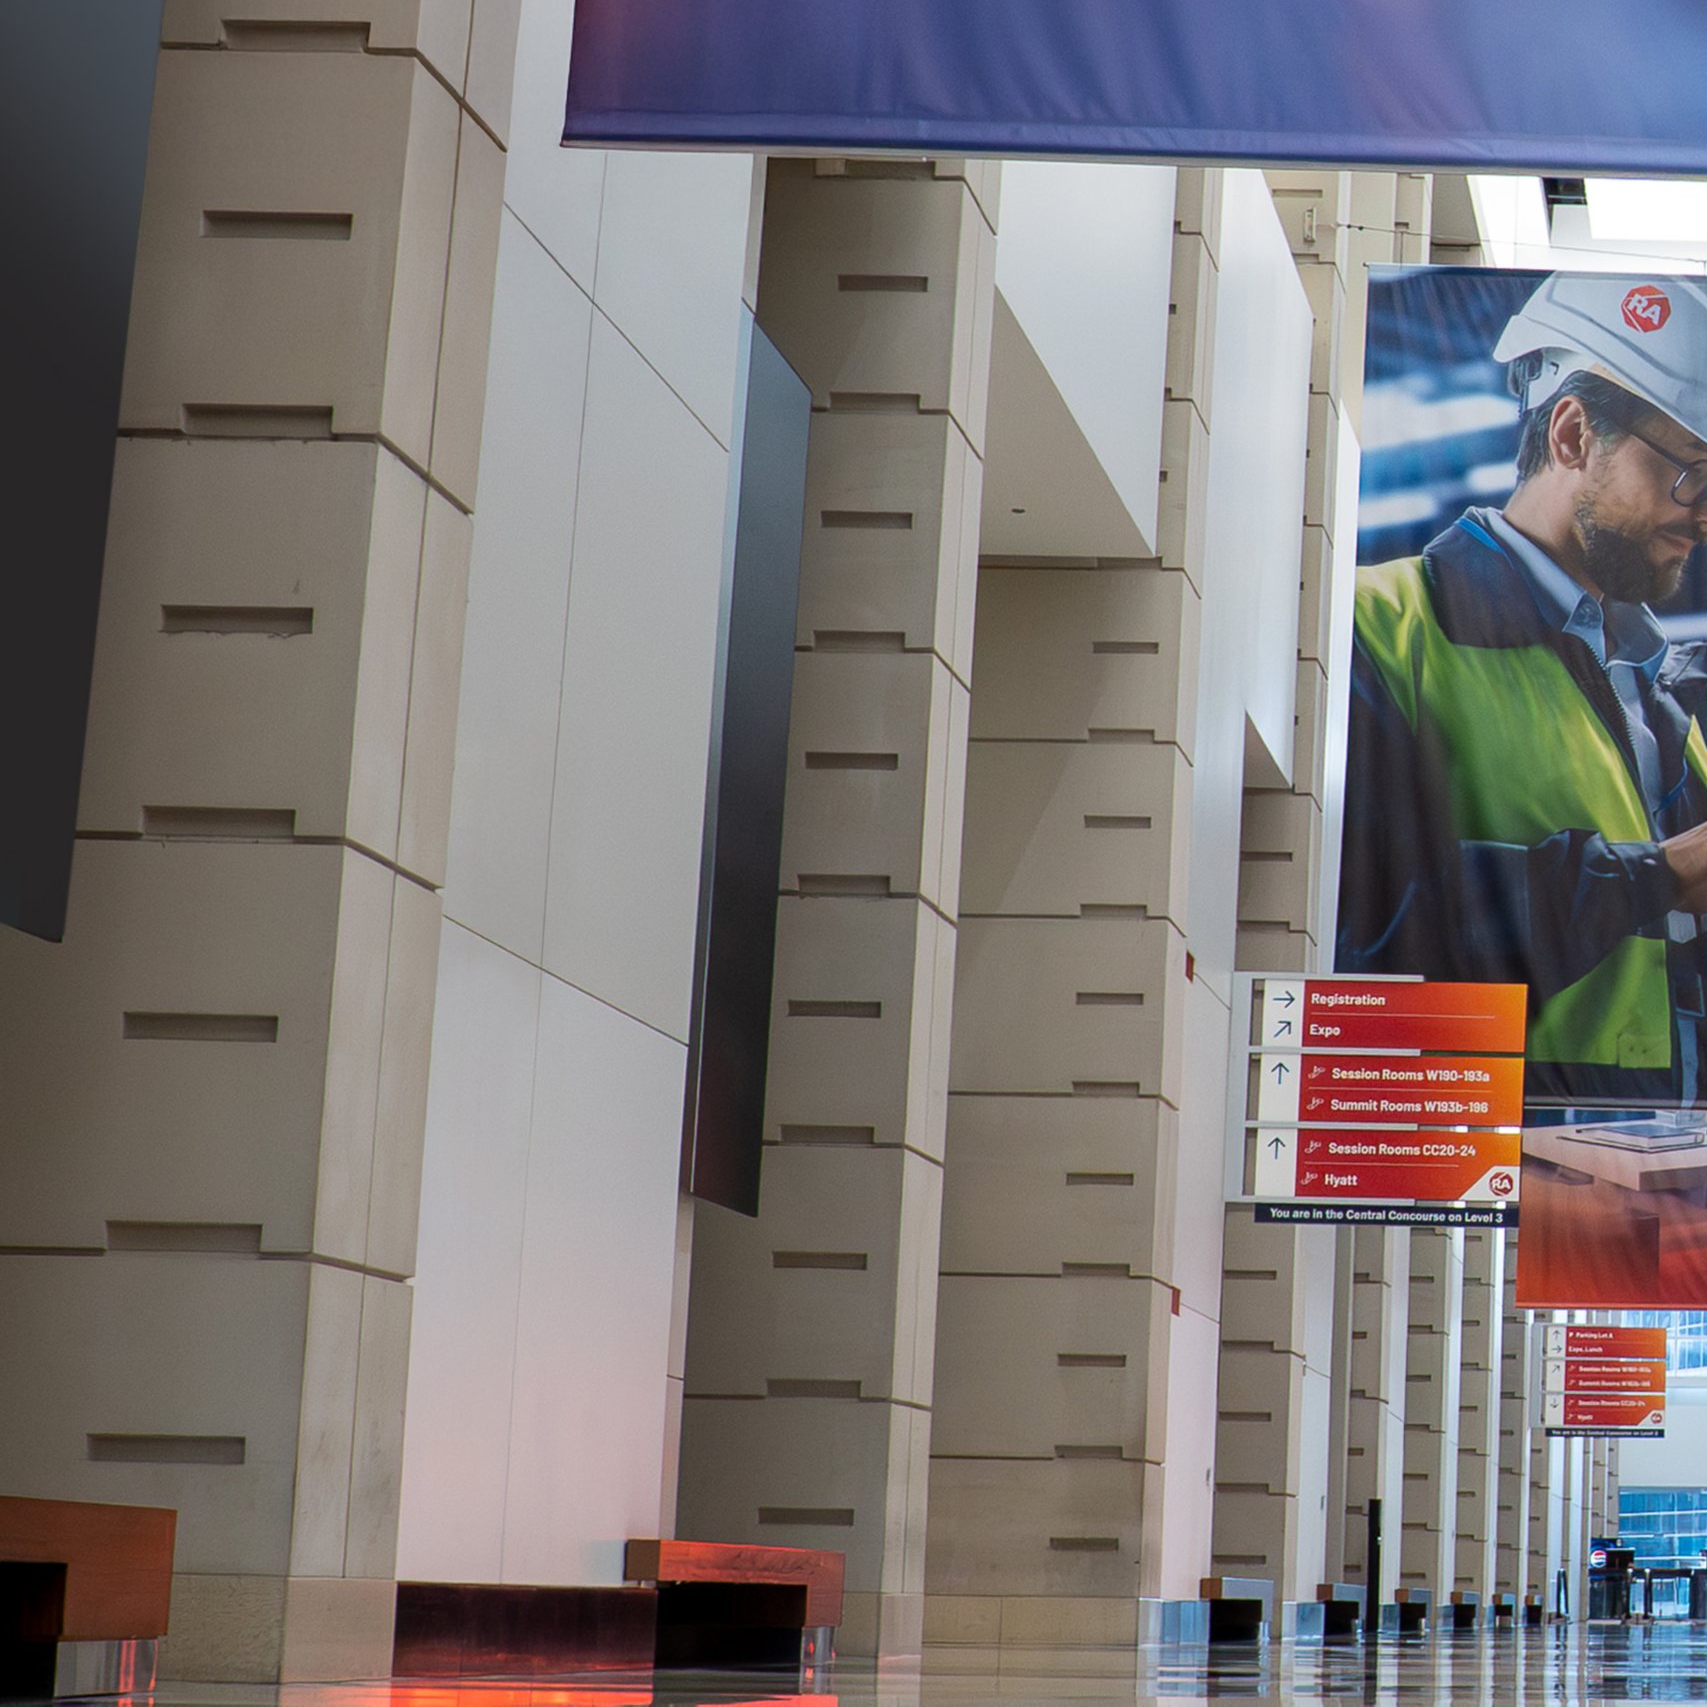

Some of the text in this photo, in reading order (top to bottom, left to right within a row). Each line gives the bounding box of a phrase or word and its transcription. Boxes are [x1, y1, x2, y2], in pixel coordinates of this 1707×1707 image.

[1627, 293, 1662, 325] RA
[1311, 993, 1386, 1007] Registration
[1310, 1024, 1341, 1038] Expo
[1332, 1068, 1380, 1080] Session
[1382, 1069, 1424, 1081] Rooms
[1331, 1099, 1378, 1111] Summit
[1380, 1100, 1422, 1112] Rooms
[1328, 1142, 1476, 1157] Session Rooms CC20-24
[1324, 1173, 1358, 1188] Hyatt
[1270, 1208, 1503, 1223] You are in the Central Concourse on Level 3
